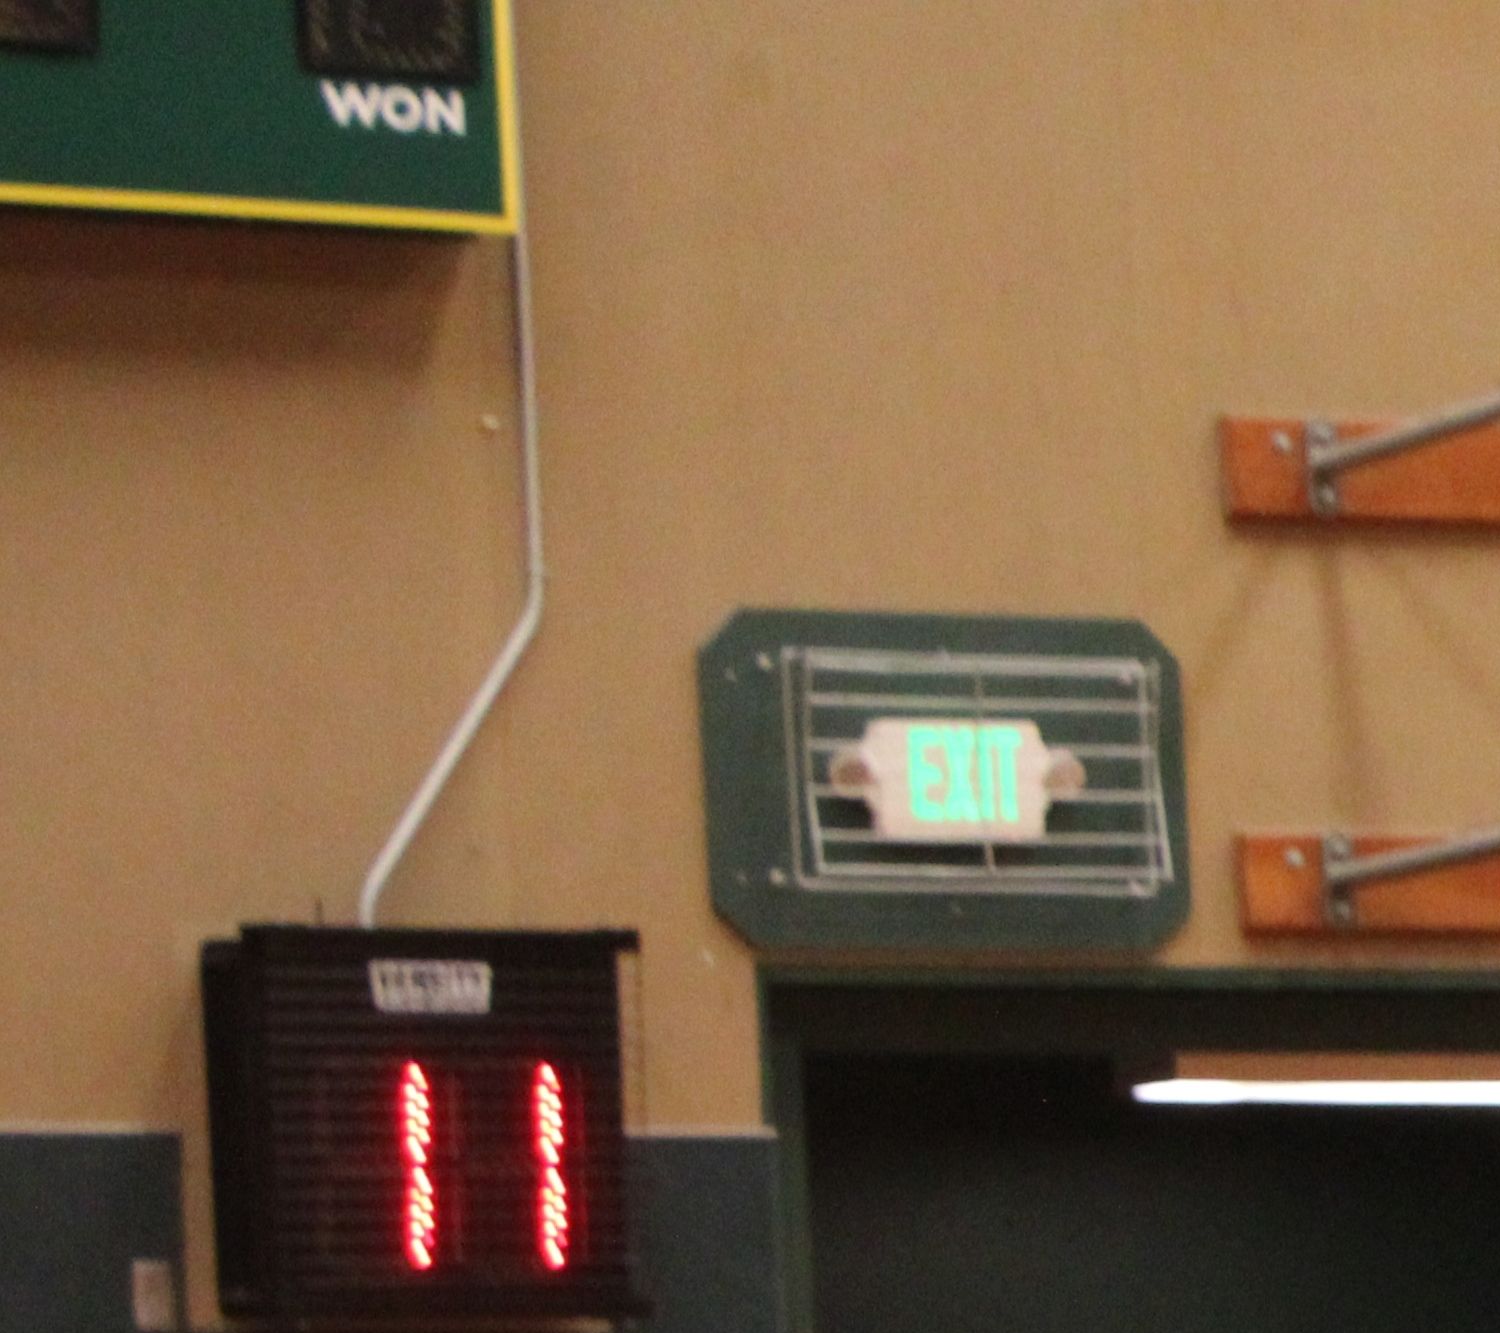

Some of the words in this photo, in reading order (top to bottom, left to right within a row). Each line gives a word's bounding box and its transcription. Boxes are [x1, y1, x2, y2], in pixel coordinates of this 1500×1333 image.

[319, 79, 467, 136] WON
[905, 725, 1024, 824] EXIT
[400, 1060, 570, 1272] 11
